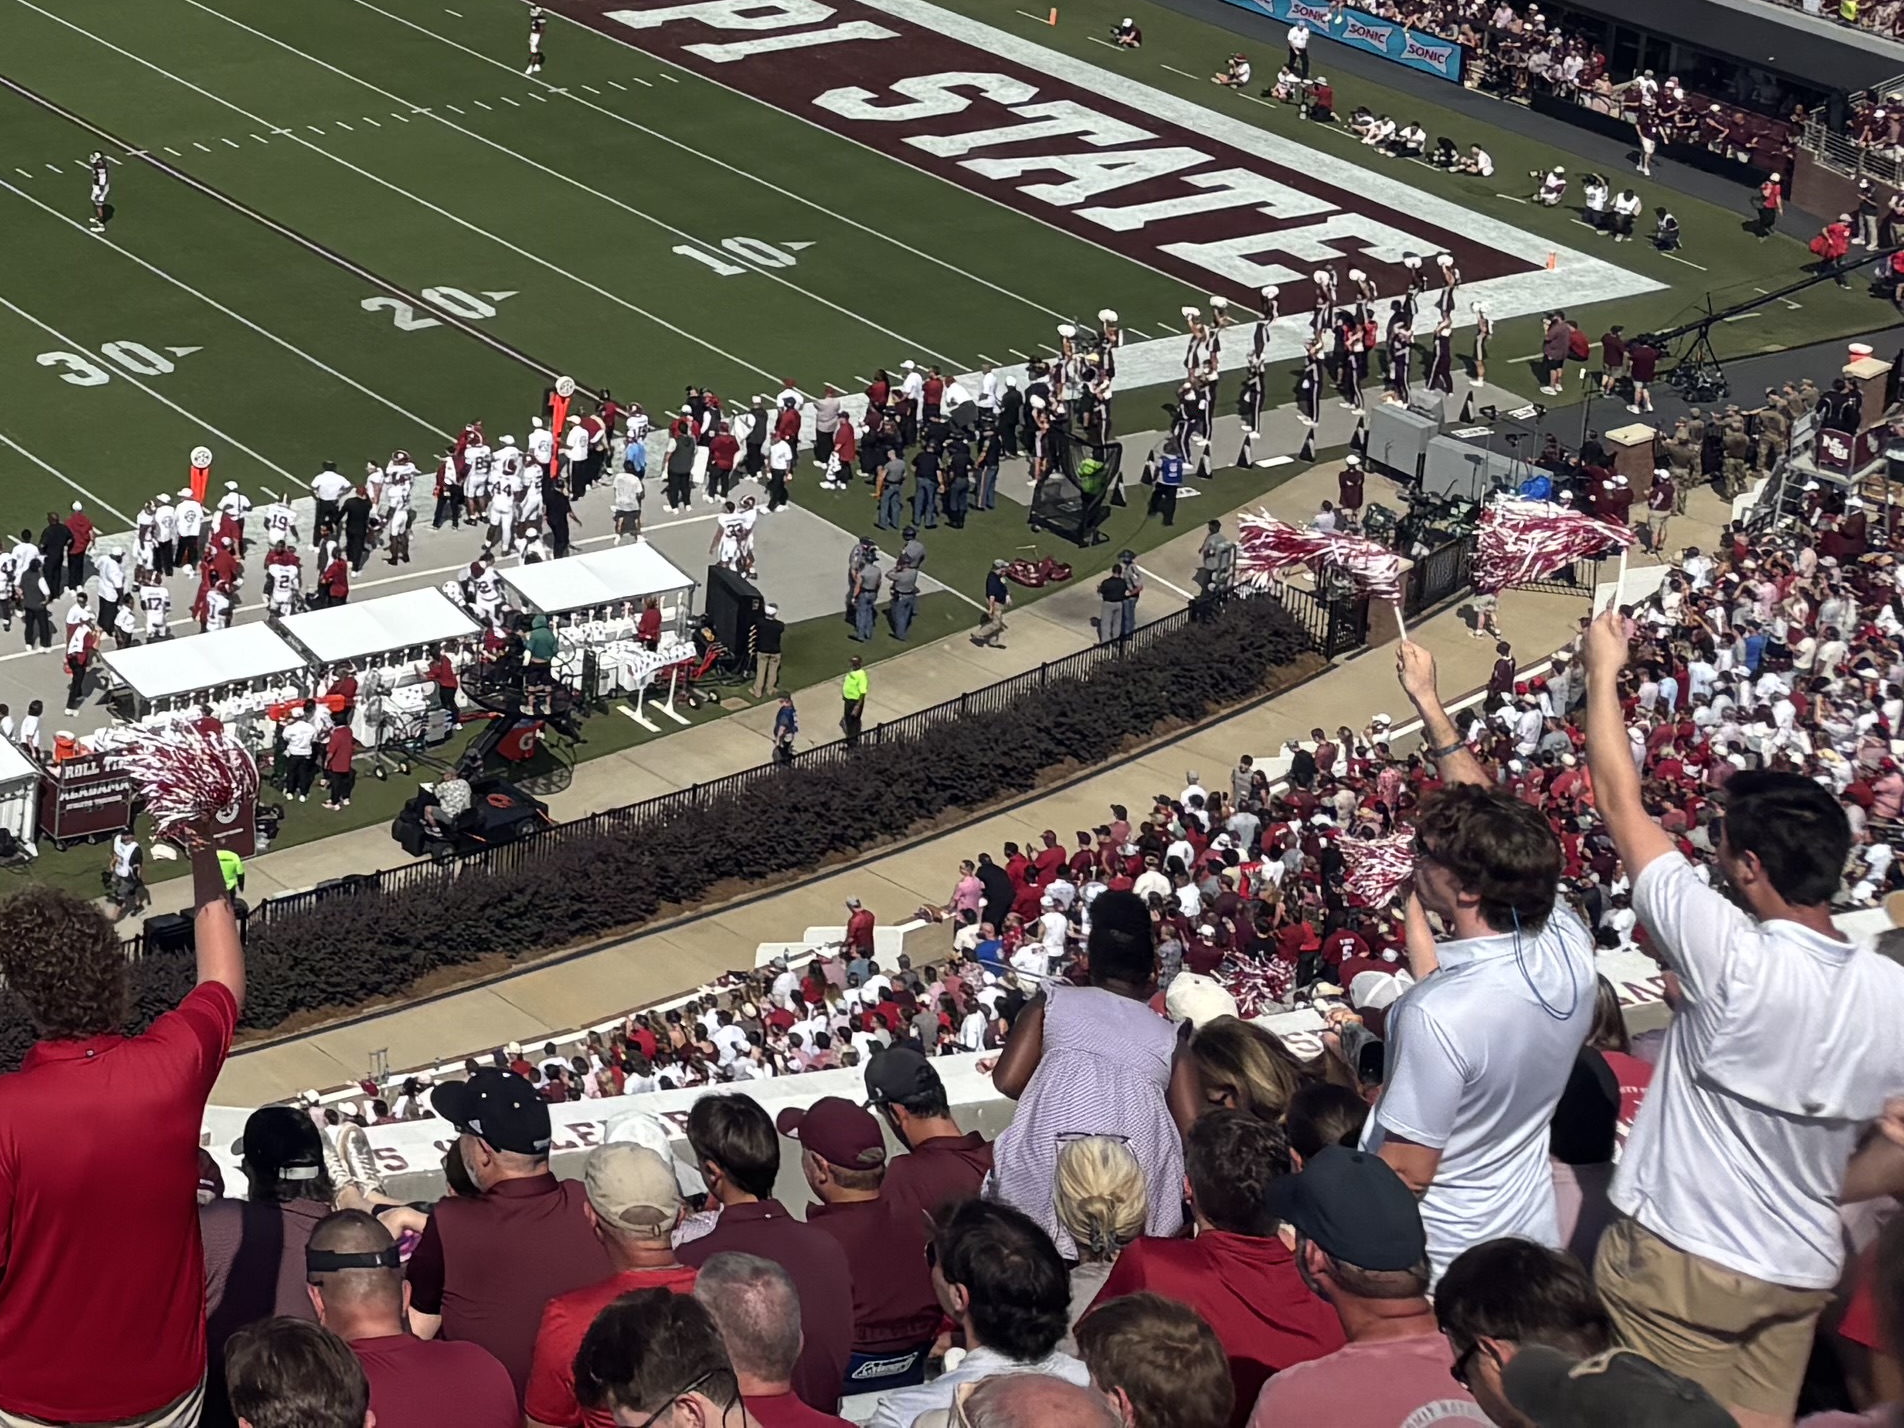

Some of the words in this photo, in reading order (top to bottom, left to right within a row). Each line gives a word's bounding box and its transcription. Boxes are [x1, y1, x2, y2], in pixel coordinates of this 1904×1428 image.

[1348, 23, 1386, 44] SONIC
[1408, 43, 1445, 64] SONIC
[811, 72, 1453, 290] STATE
[673, 236, 797, 276] 10
[359, 285, 500, 332] 20
[36, 339, 178, 387] 30
[493, 480, 513, 497] 44
[271, 516, 288, 531] 19
[279, 575, 290, 589] 2
[64, 761, 100, 779] ROLL
